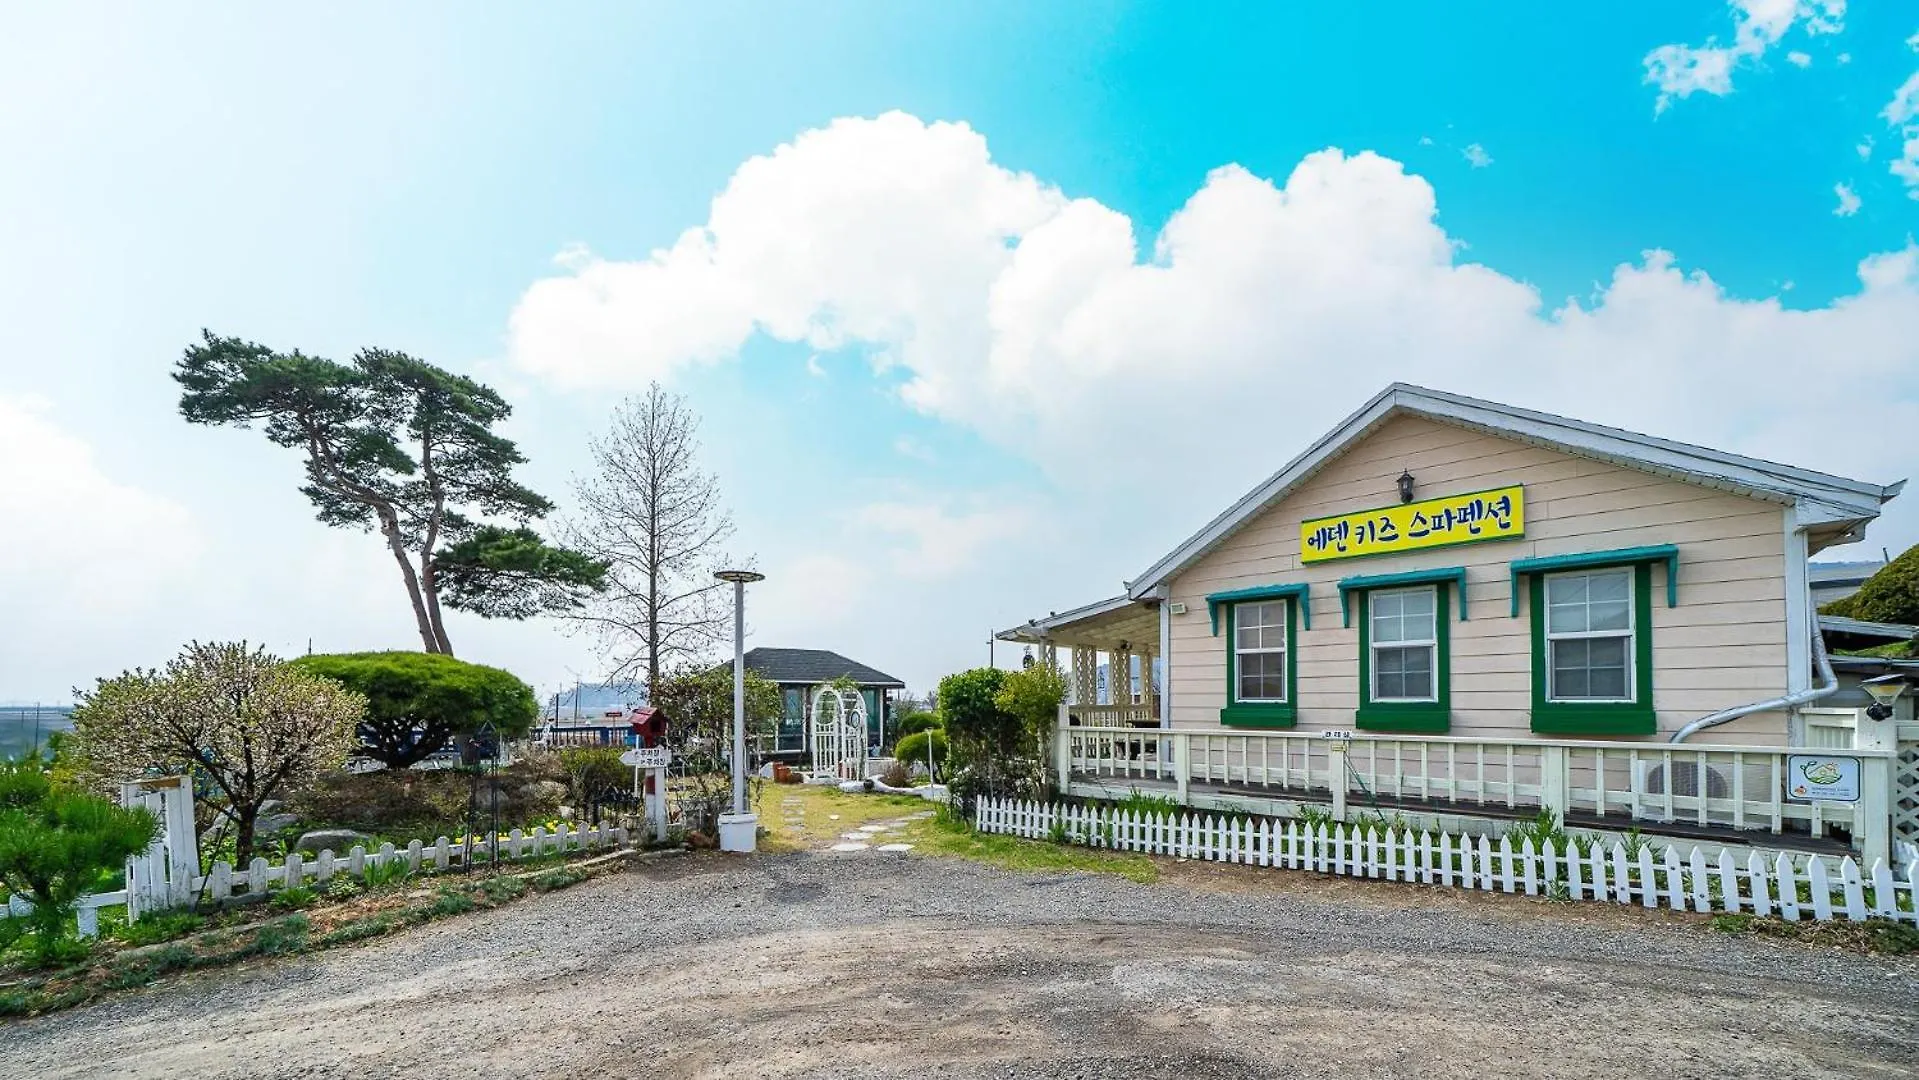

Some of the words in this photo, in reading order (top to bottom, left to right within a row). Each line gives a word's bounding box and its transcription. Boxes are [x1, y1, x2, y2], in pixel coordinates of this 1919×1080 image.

[1307, 520, 1348, 552] 에덴
[1355, 516, 1399, 545] 키즈
[1408, 495, 1512, 537] 스파펜션
